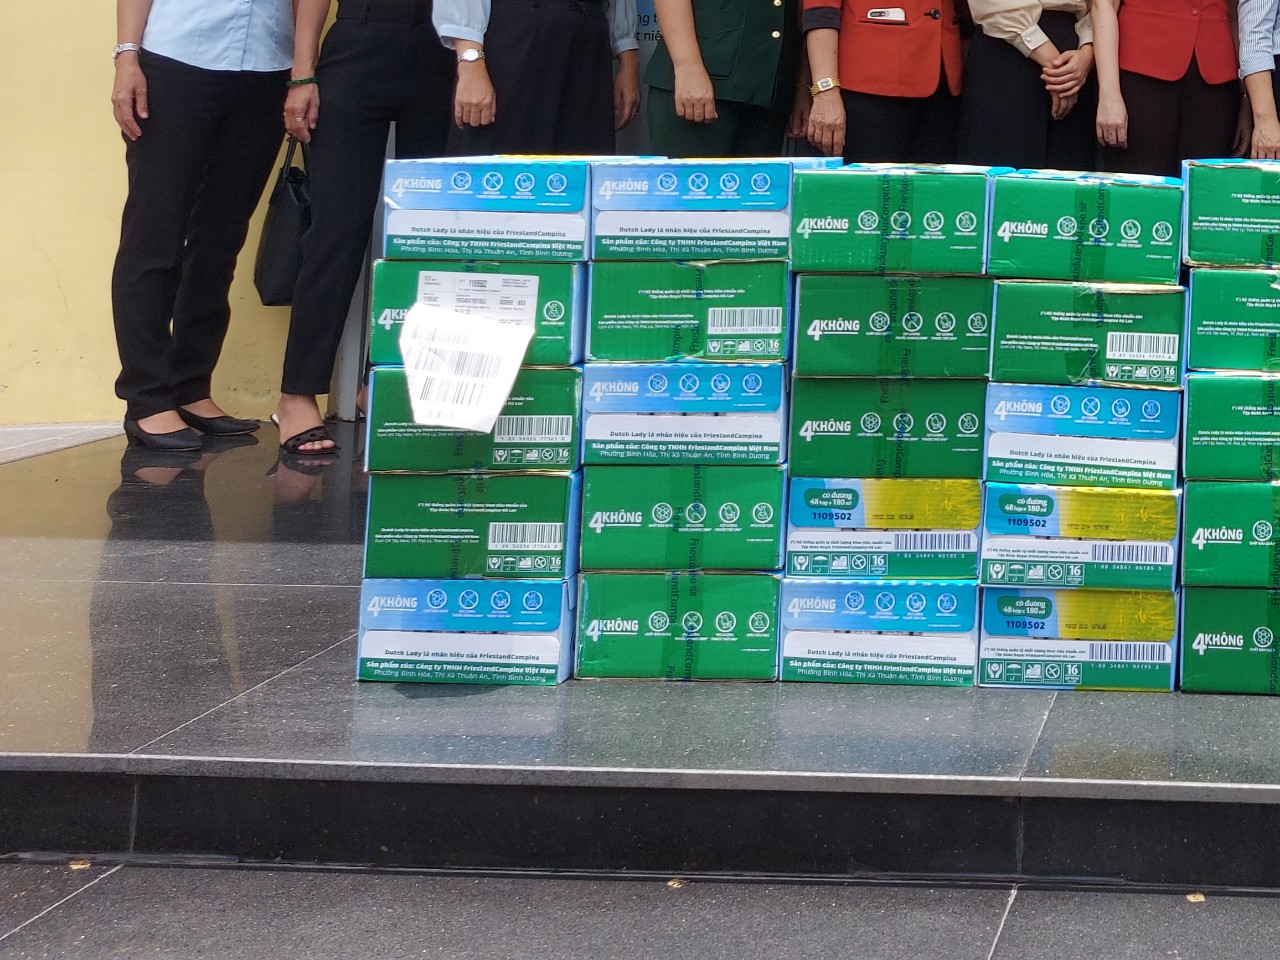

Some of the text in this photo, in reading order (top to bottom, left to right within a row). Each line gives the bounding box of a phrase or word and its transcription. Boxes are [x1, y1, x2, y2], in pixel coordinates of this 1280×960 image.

[378, 308, 405, 330] 4KH
[610, 430, 630, 438] Dutch
[631, 431, 647, 439] Lady
[703, 432, 763, 441] FrieslandCampina
[812, 512, 852, 521] 1109502
[1007, 518, 1047, 528] 1109502
[872, 555, 885, 566] 16
[1069, 565, 1081, 576] 16
[1006, 620, 1046, 630] 1109502
[1066, 665, 1078, 676] 16
